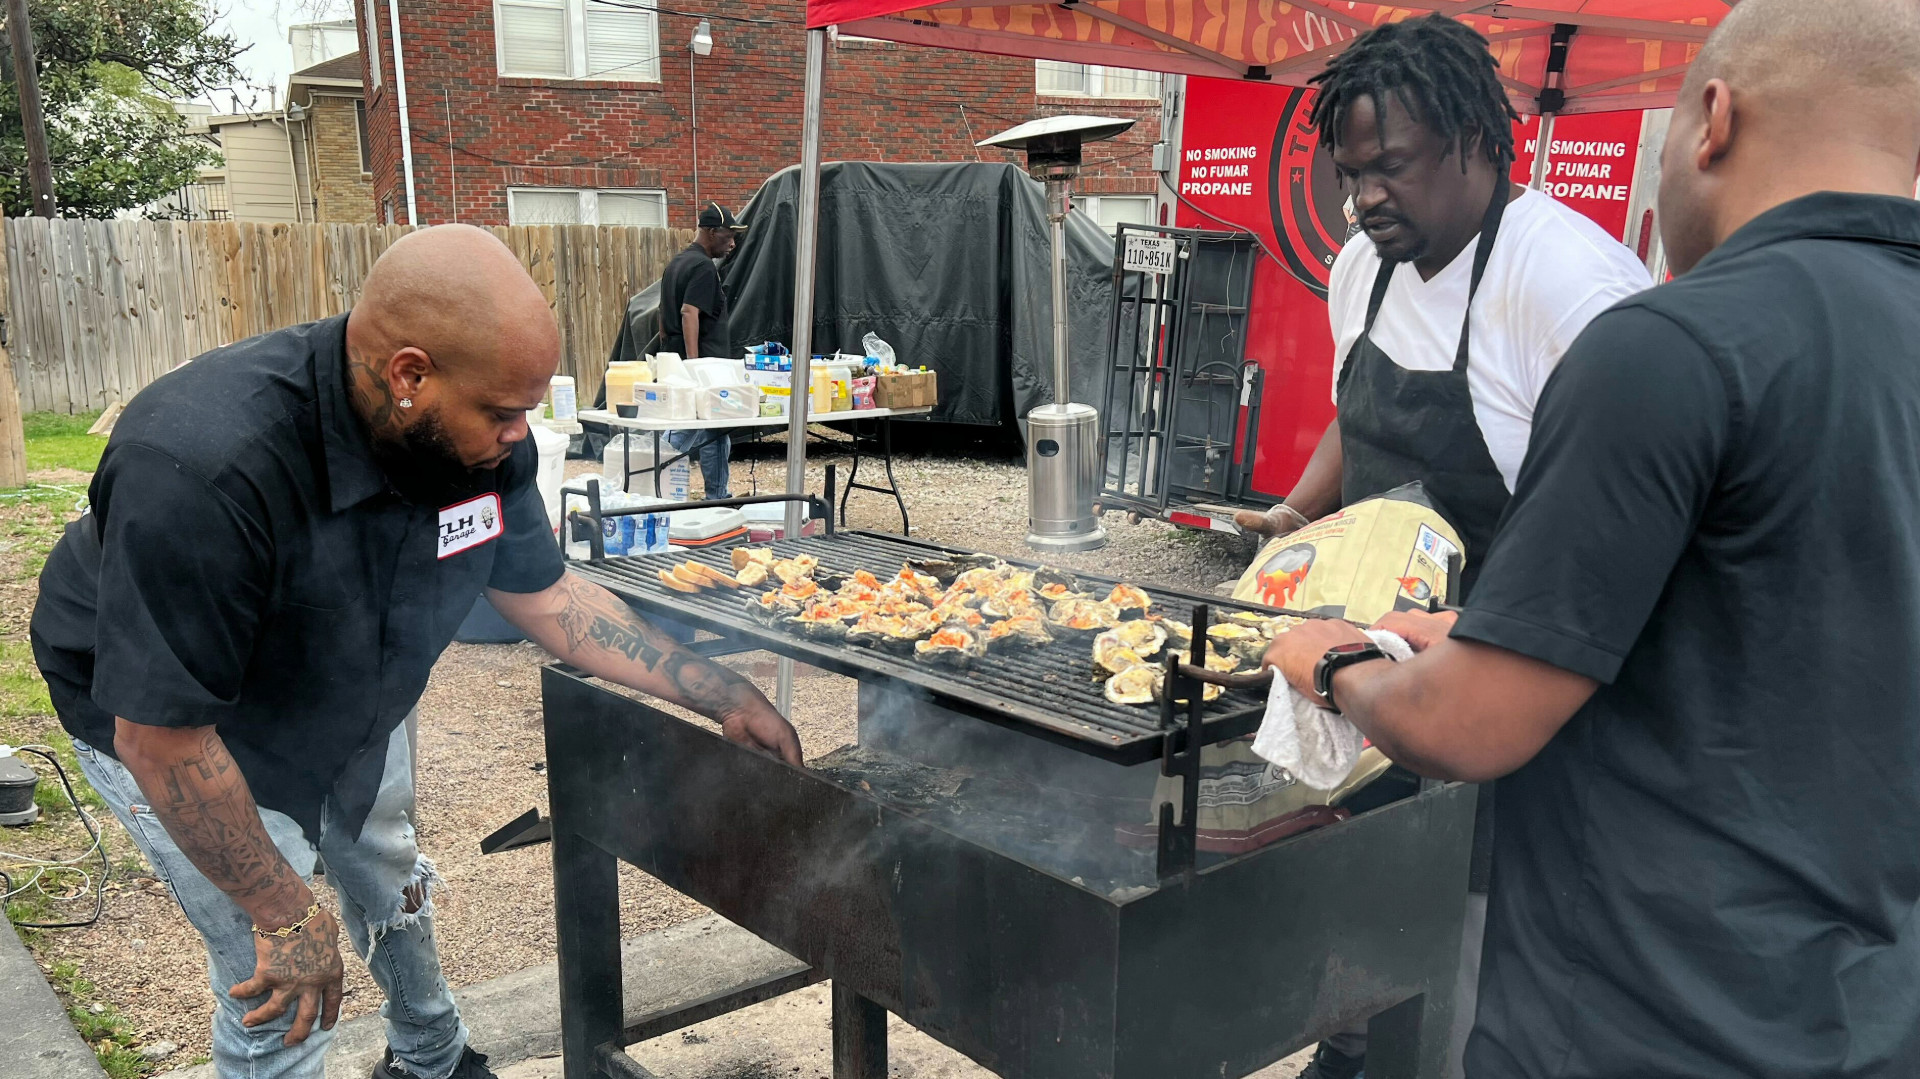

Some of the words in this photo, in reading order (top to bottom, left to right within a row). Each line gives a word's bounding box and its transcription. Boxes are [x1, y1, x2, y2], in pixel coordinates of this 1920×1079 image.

[1186, 149, 1202, 161] NO
[1204, 146, 1257, 161] SMOKING
[1550, 139, 1626, 157] SMOKING
[1191, 166, 1207, 179] NO
[1209, 164, 1249, 178] FUMAR
[1555, 161, 1612, 179] FUMAR
[1181, 182, 1253, 196] PROPANE
[1528, 181, 1628, 201] ROPANE
[1140, 239, 1160, 247] TEXAS
[441, 527, 477, 547] Garage
